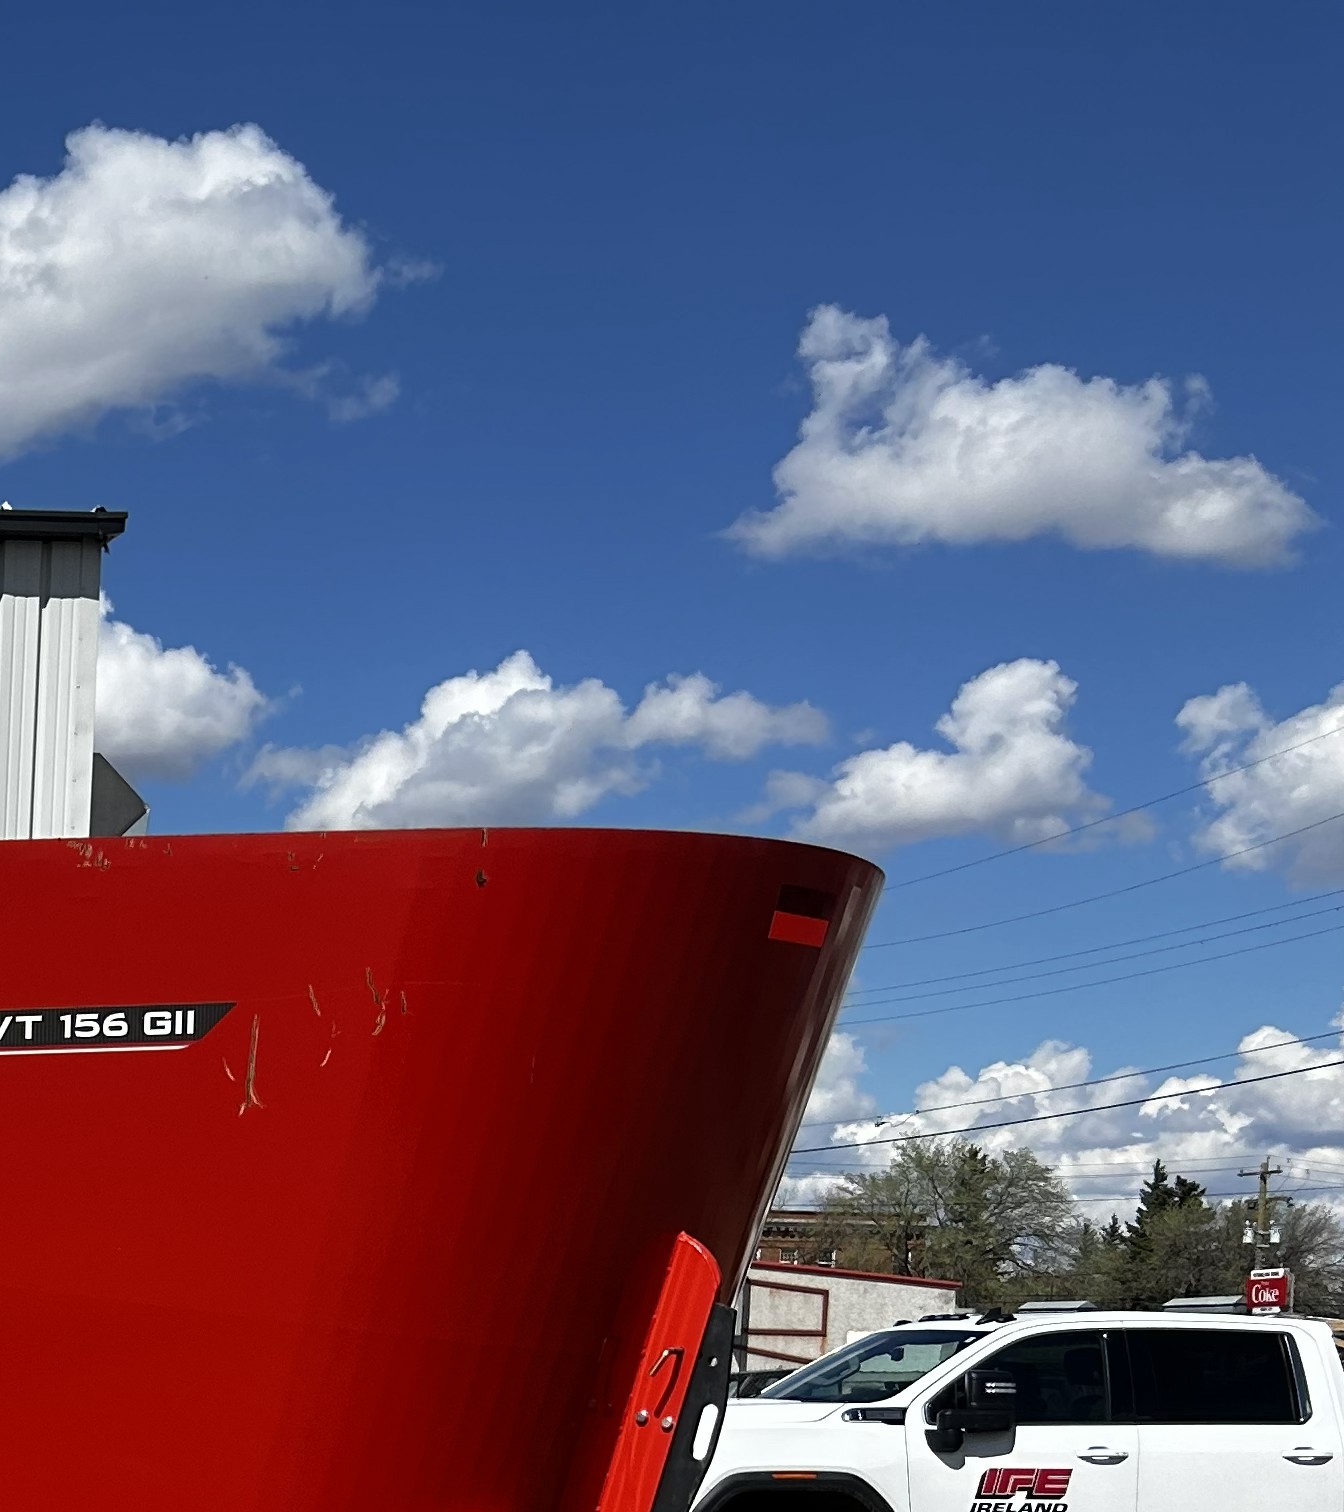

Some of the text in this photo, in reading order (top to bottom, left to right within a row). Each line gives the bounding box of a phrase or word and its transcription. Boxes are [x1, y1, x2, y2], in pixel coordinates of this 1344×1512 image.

[59, 1012, 129, 1039] 156
[143, 1009, 195, 1036] GII
[1252, 1284, 1280, 1303] Coke
[975, 1468, 1074, 1500] IFE
